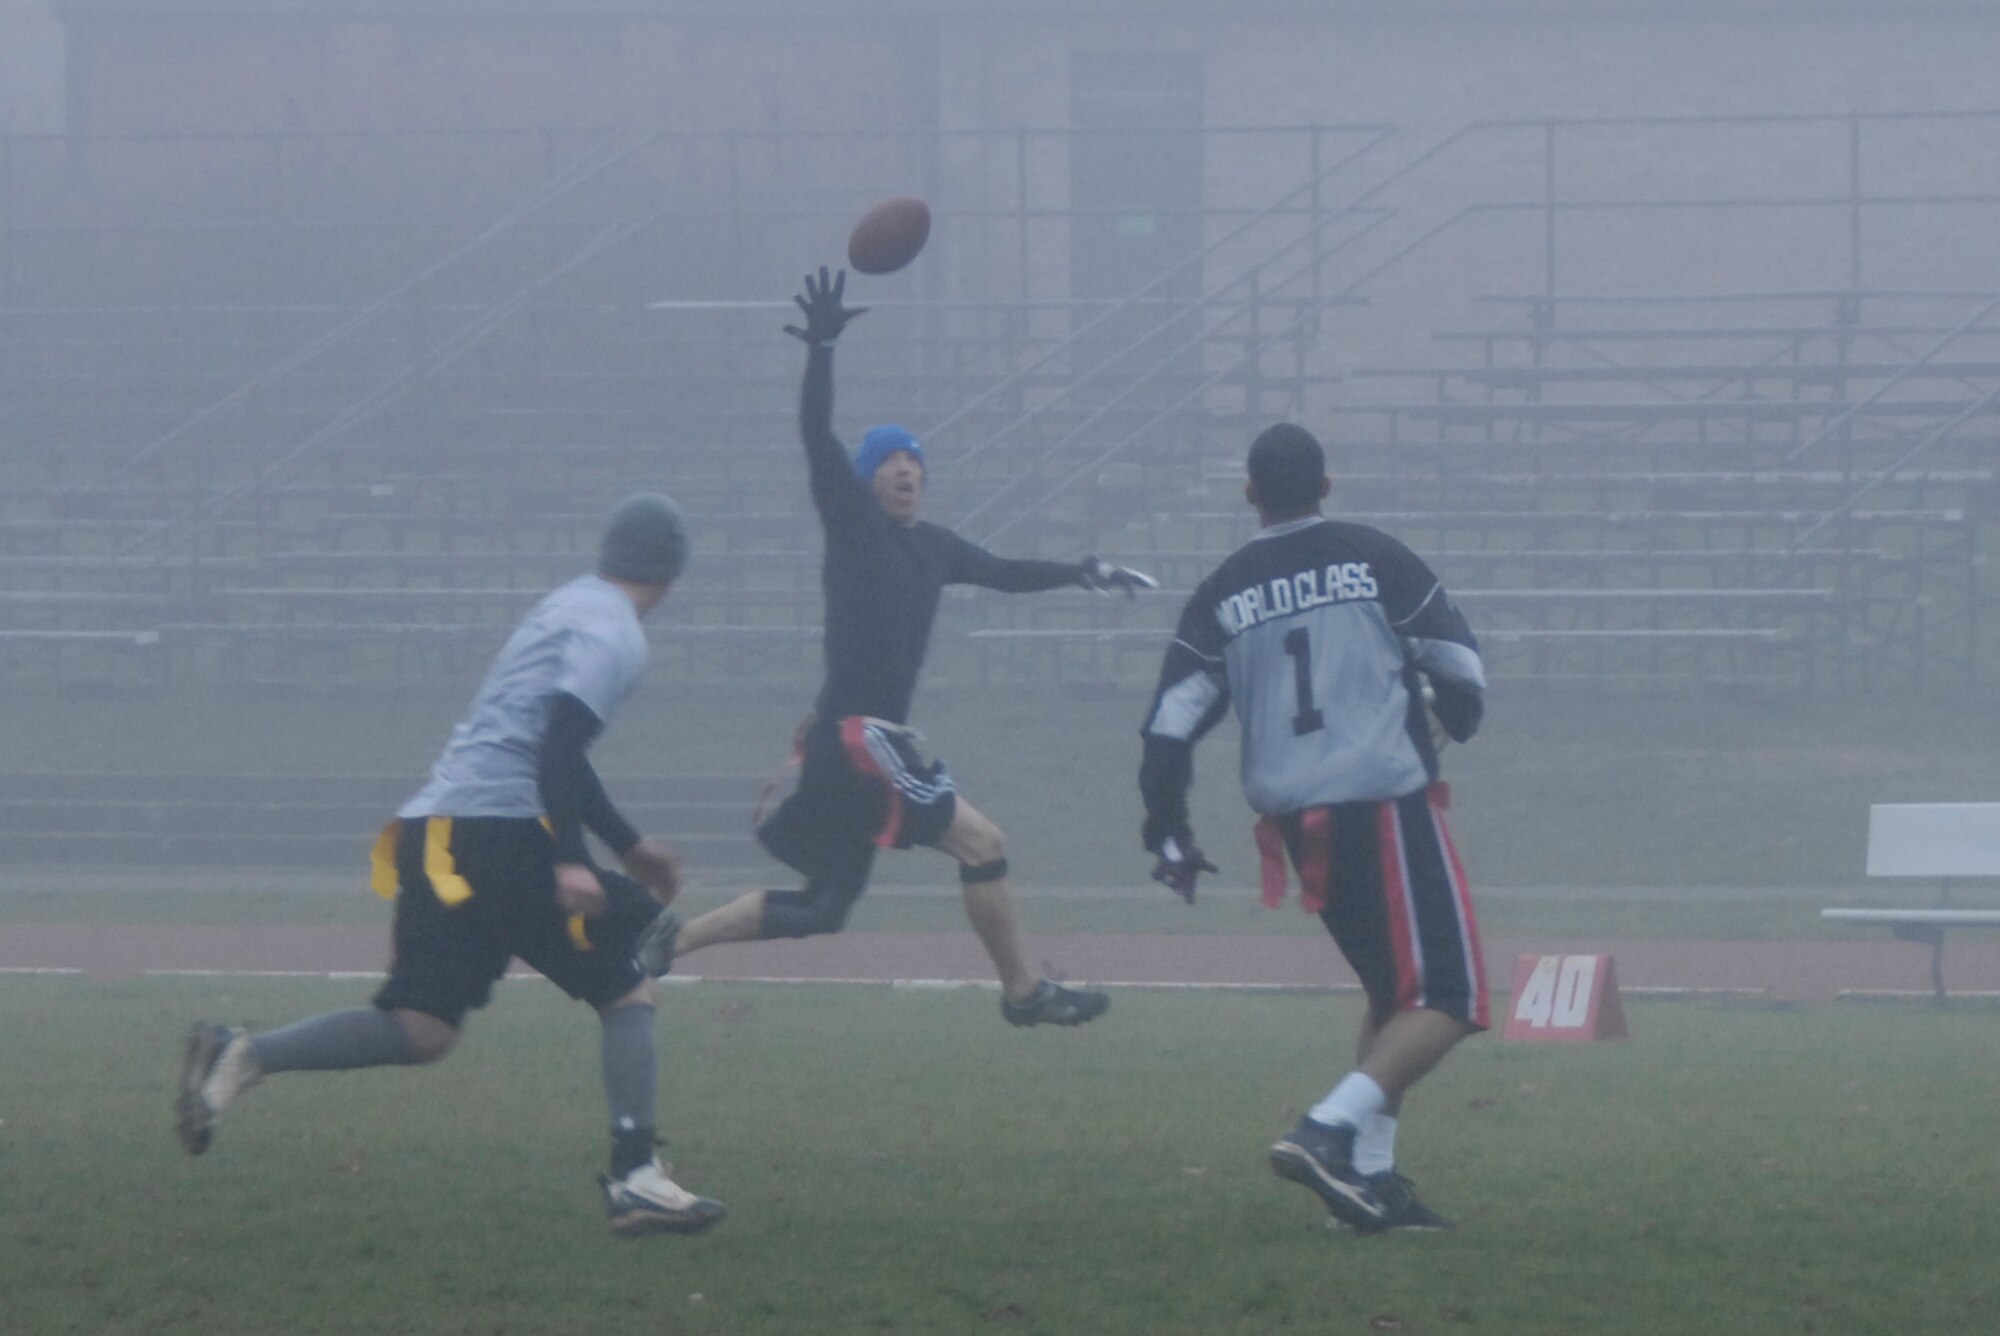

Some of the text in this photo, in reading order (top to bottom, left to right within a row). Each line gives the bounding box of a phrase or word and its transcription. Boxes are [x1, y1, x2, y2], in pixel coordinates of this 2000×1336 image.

[1294, 562, 1378, 609] CLASS
[1284, 626, 1325, 736] 1
[1514, 954, 1598, 1028] 40
